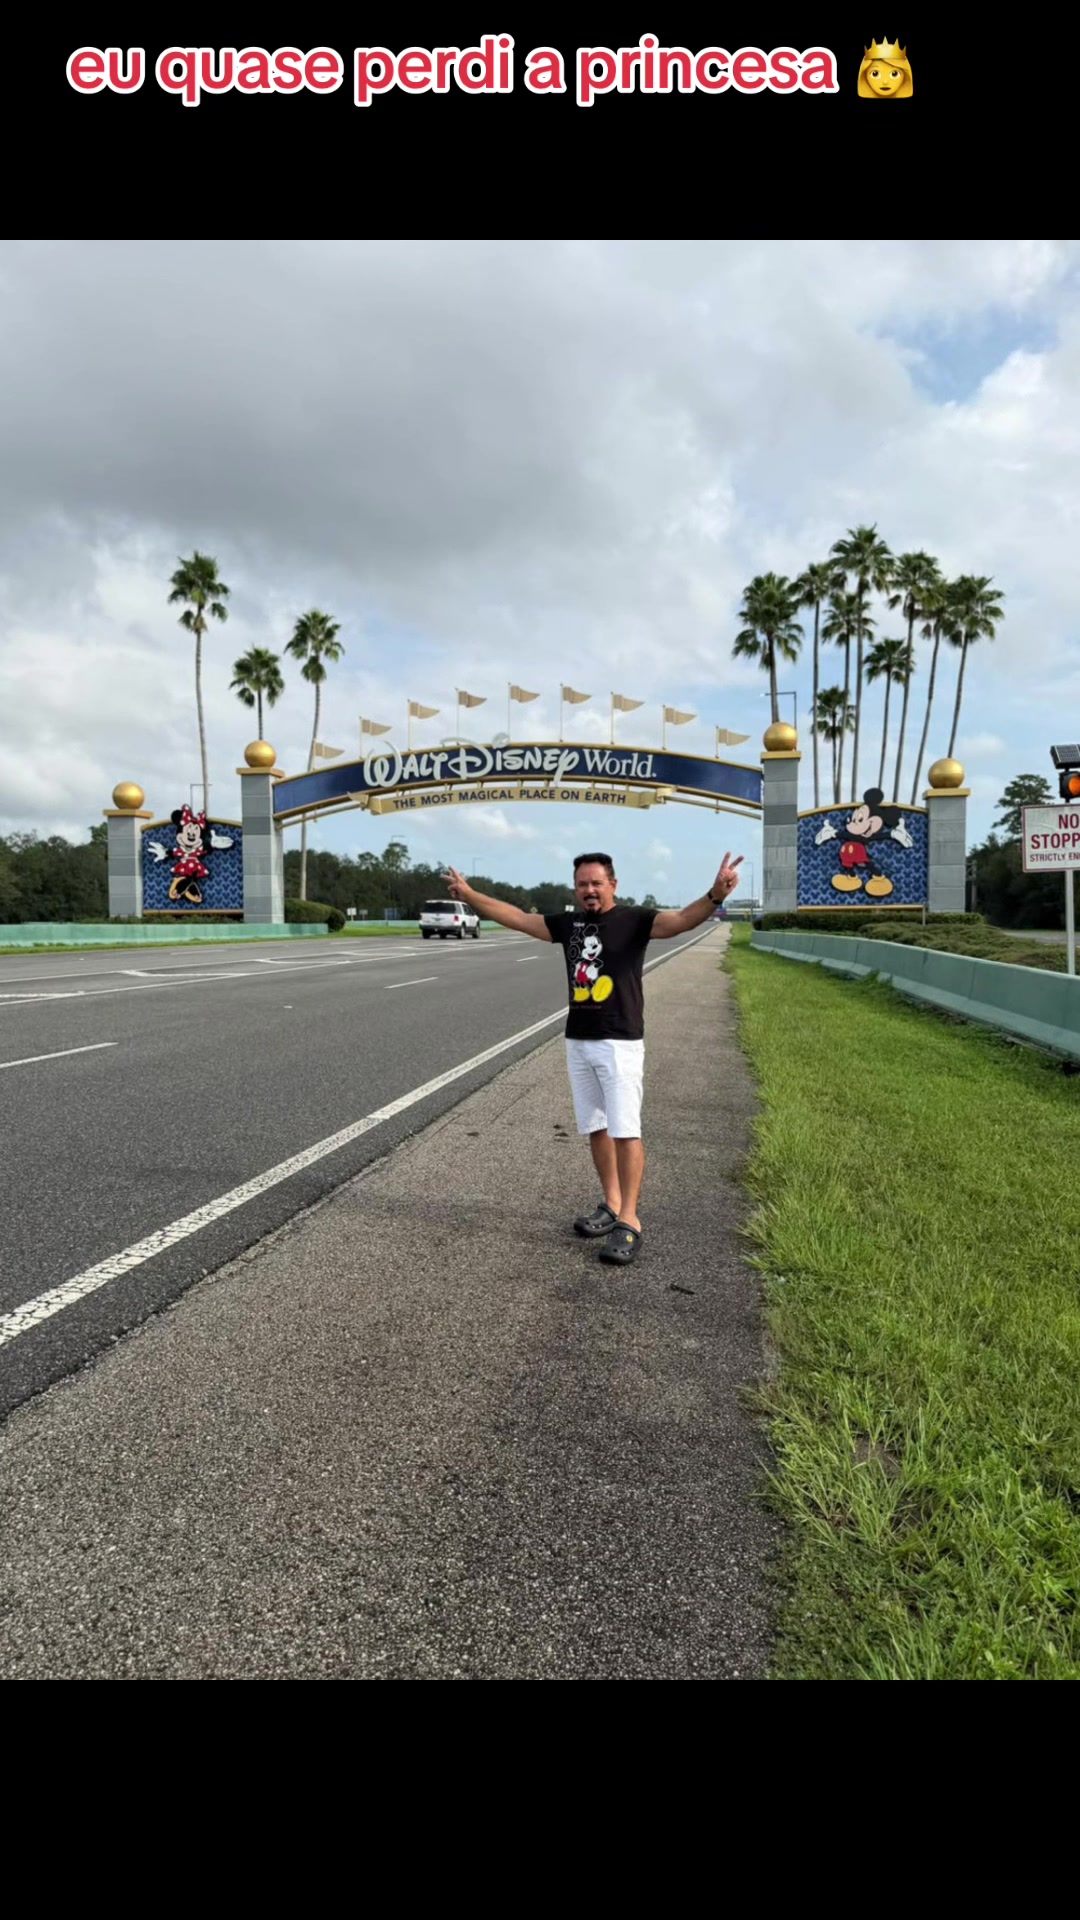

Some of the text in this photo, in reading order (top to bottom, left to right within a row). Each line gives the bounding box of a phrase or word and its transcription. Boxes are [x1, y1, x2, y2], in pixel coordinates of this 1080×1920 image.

[393, 788, 626, 809] THE MOST MAGICAL PLACE ON EARTH
[1058, 813, 1080, 829] NO
[1029, 852, 1080, 862] STRICTLY EN
